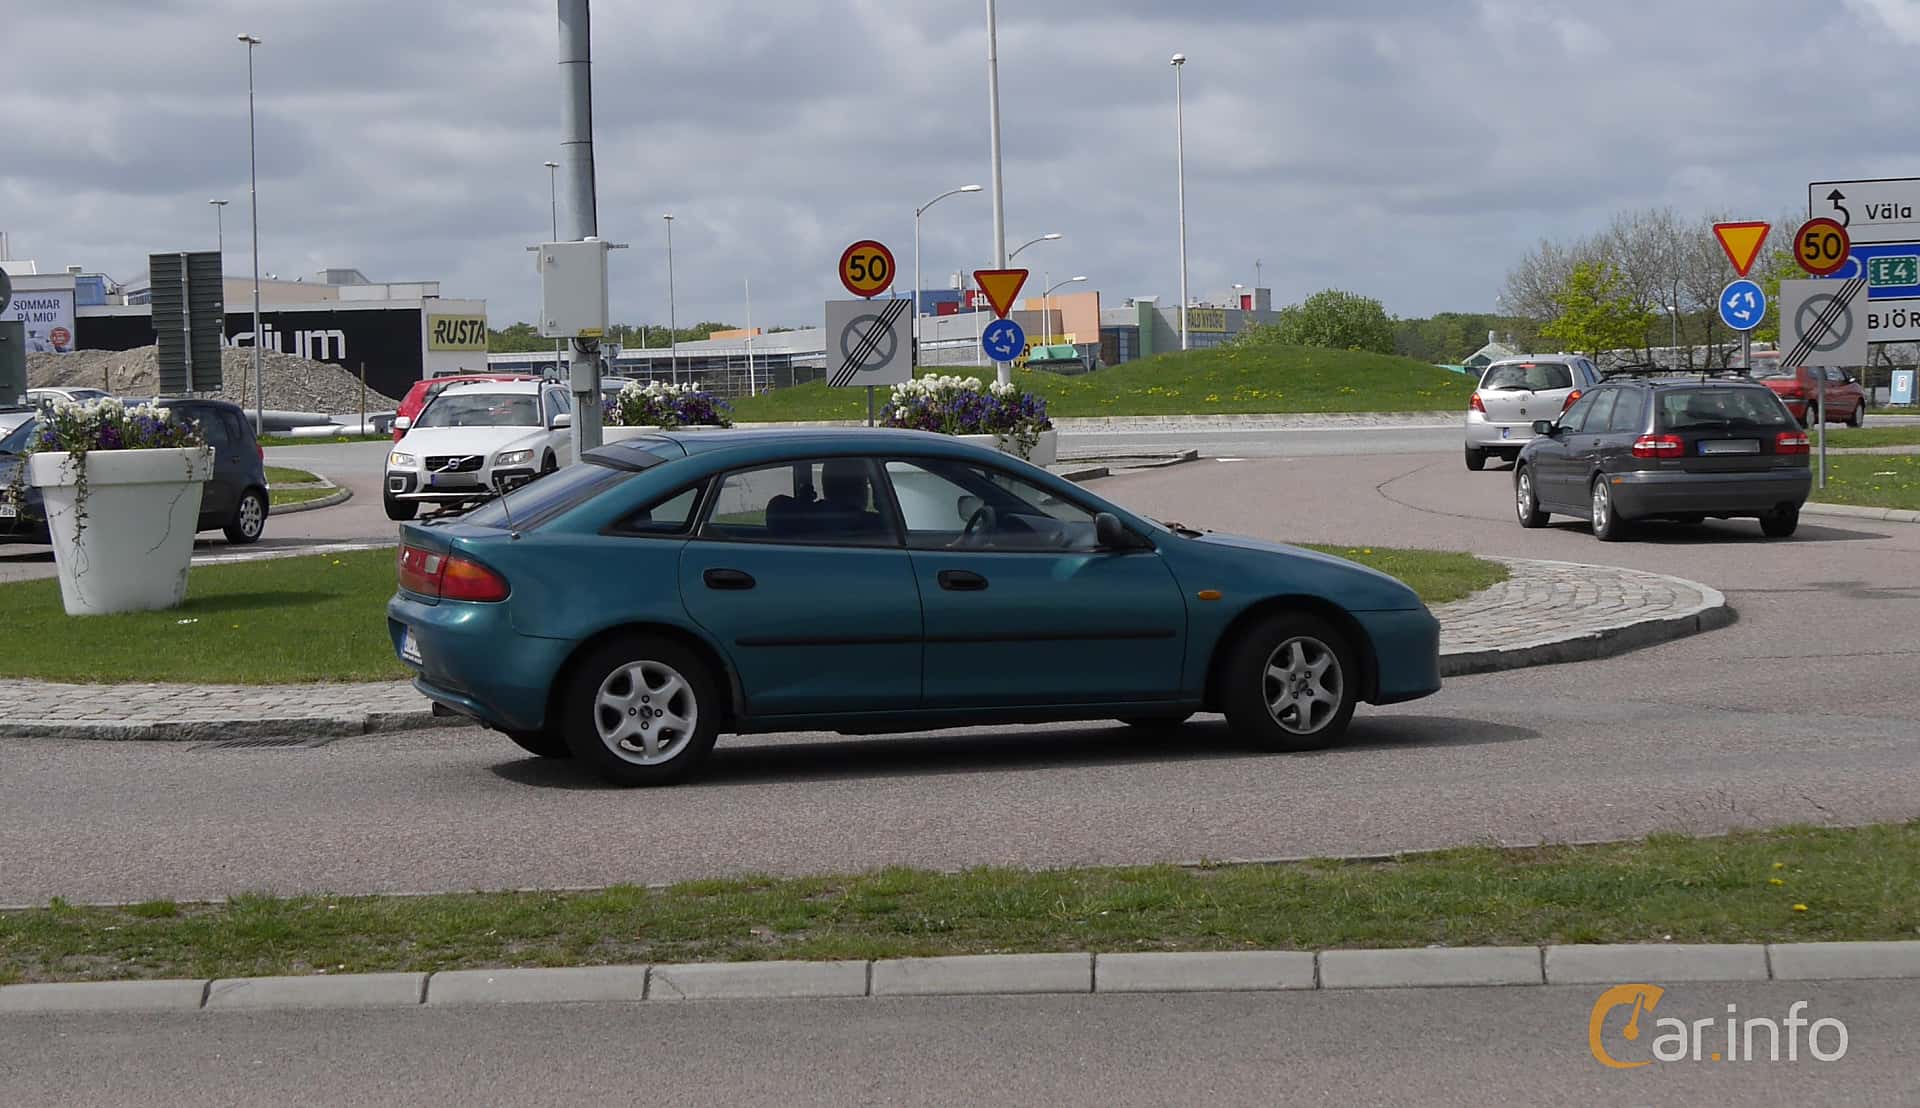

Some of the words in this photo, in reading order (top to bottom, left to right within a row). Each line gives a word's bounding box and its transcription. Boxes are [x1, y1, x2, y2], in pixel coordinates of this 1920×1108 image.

[1864, 203, 1912, 220] Väla
[1804, 232, 1841, 260] 50
[850, 255, 887, 282] 50
[13, 298, 61, 311] SOMMAR
[17, 311, 31, 323] PÅ
[434, 319, 486, 345] RUSTA
